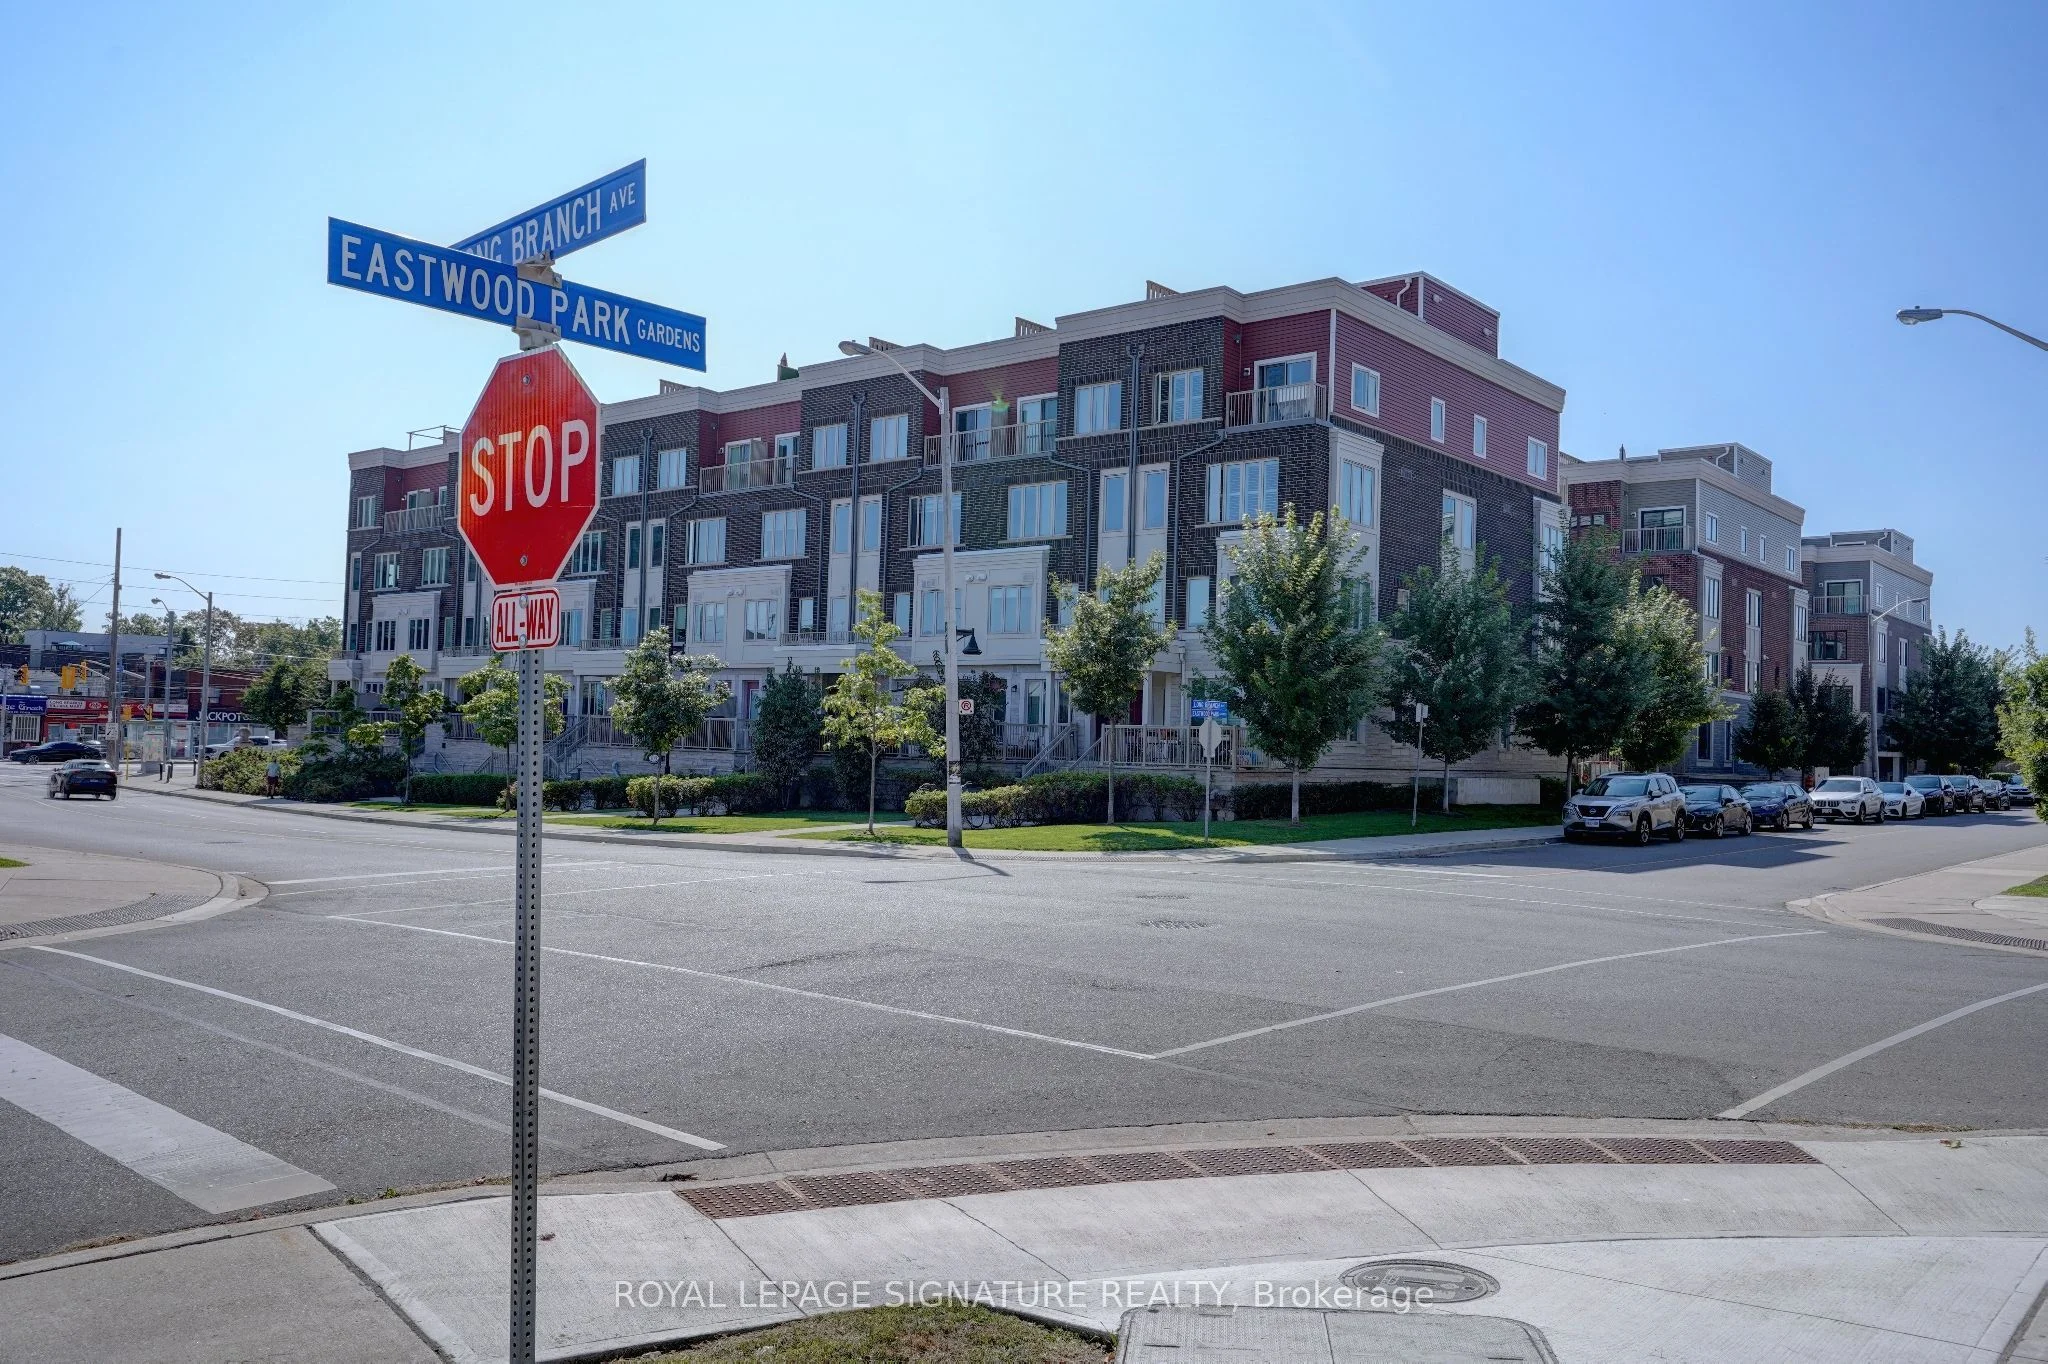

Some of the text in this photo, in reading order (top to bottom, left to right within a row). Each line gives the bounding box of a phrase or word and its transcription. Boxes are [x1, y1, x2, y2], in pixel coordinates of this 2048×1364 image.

[511, 189, 600, 266] BRANCH
[609, 182, 636, 214] AVE
[340, 233, 535, 320] EASTWOOD
[551, 290, 631, 346] PARK
[637, 318, 700, 353] GARDENS
[469, 419, 590, 517] STOP
[495, 598, 555, 643] ALL-WAY
[195, 711, 242, 722] JCKPOT
